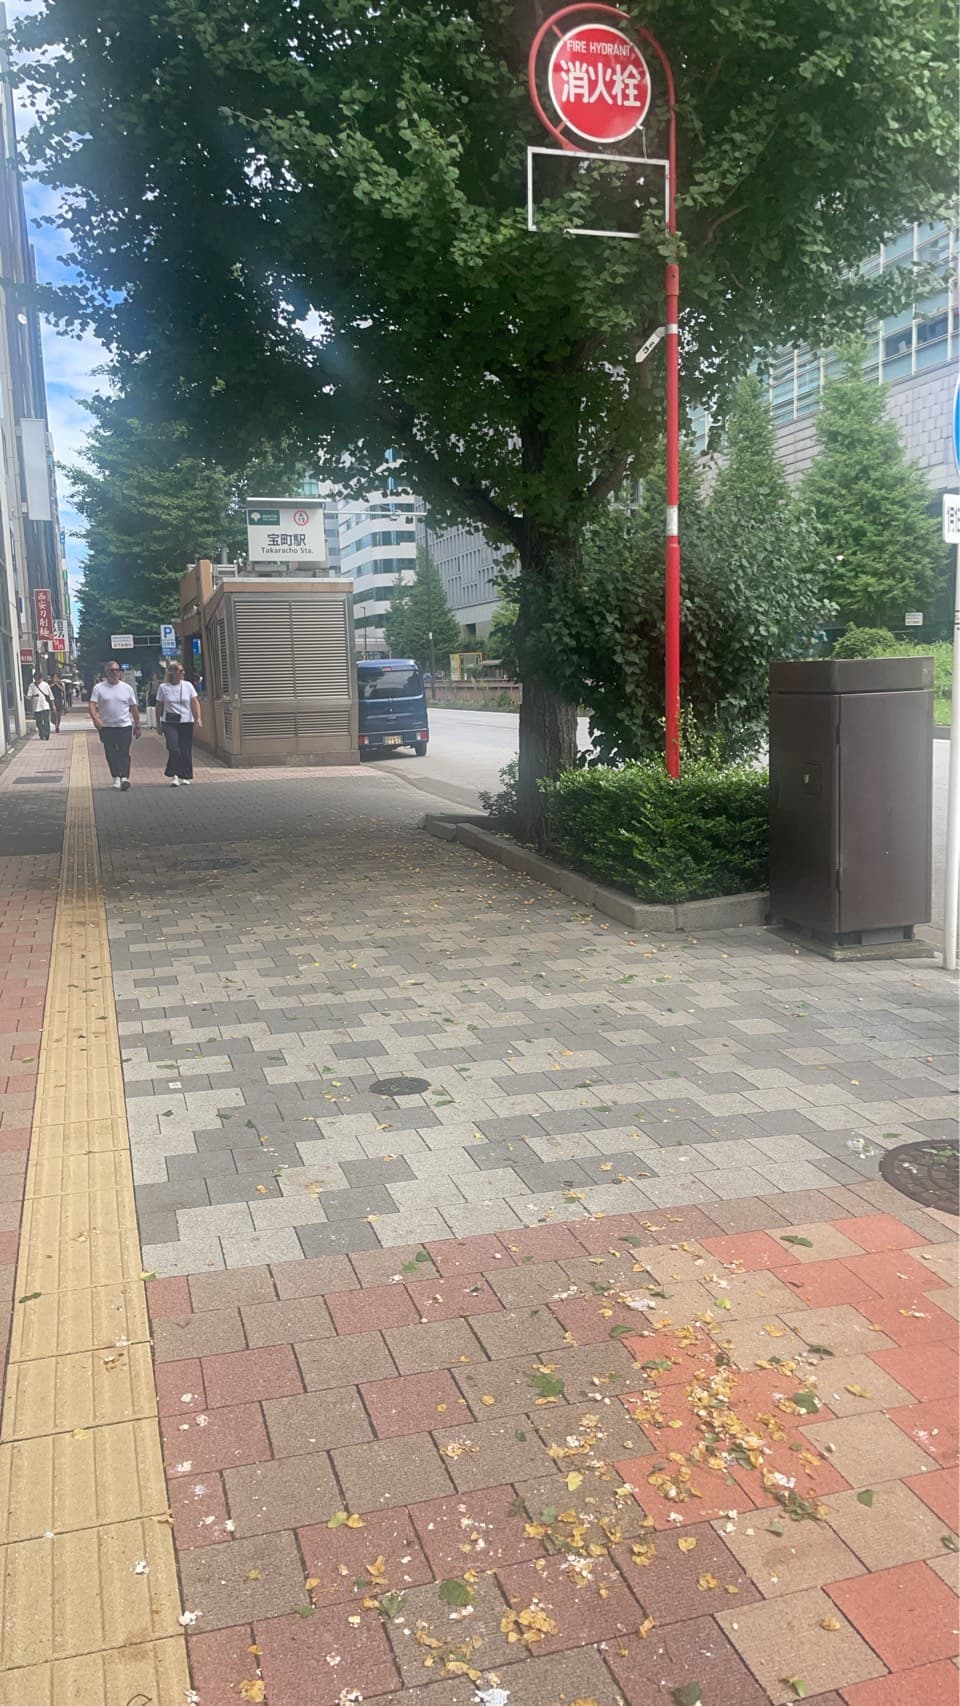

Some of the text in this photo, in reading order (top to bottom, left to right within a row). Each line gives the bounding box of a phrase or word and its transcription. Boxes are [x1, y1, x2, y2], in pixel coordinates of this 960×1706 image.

[567, 40, 631, 56] FIRE HYDRANT
[560, 60, 641, 107] 消火栓
[267, 533, 306, 546] 宝町駅
[163, 626, 173, 638] P
